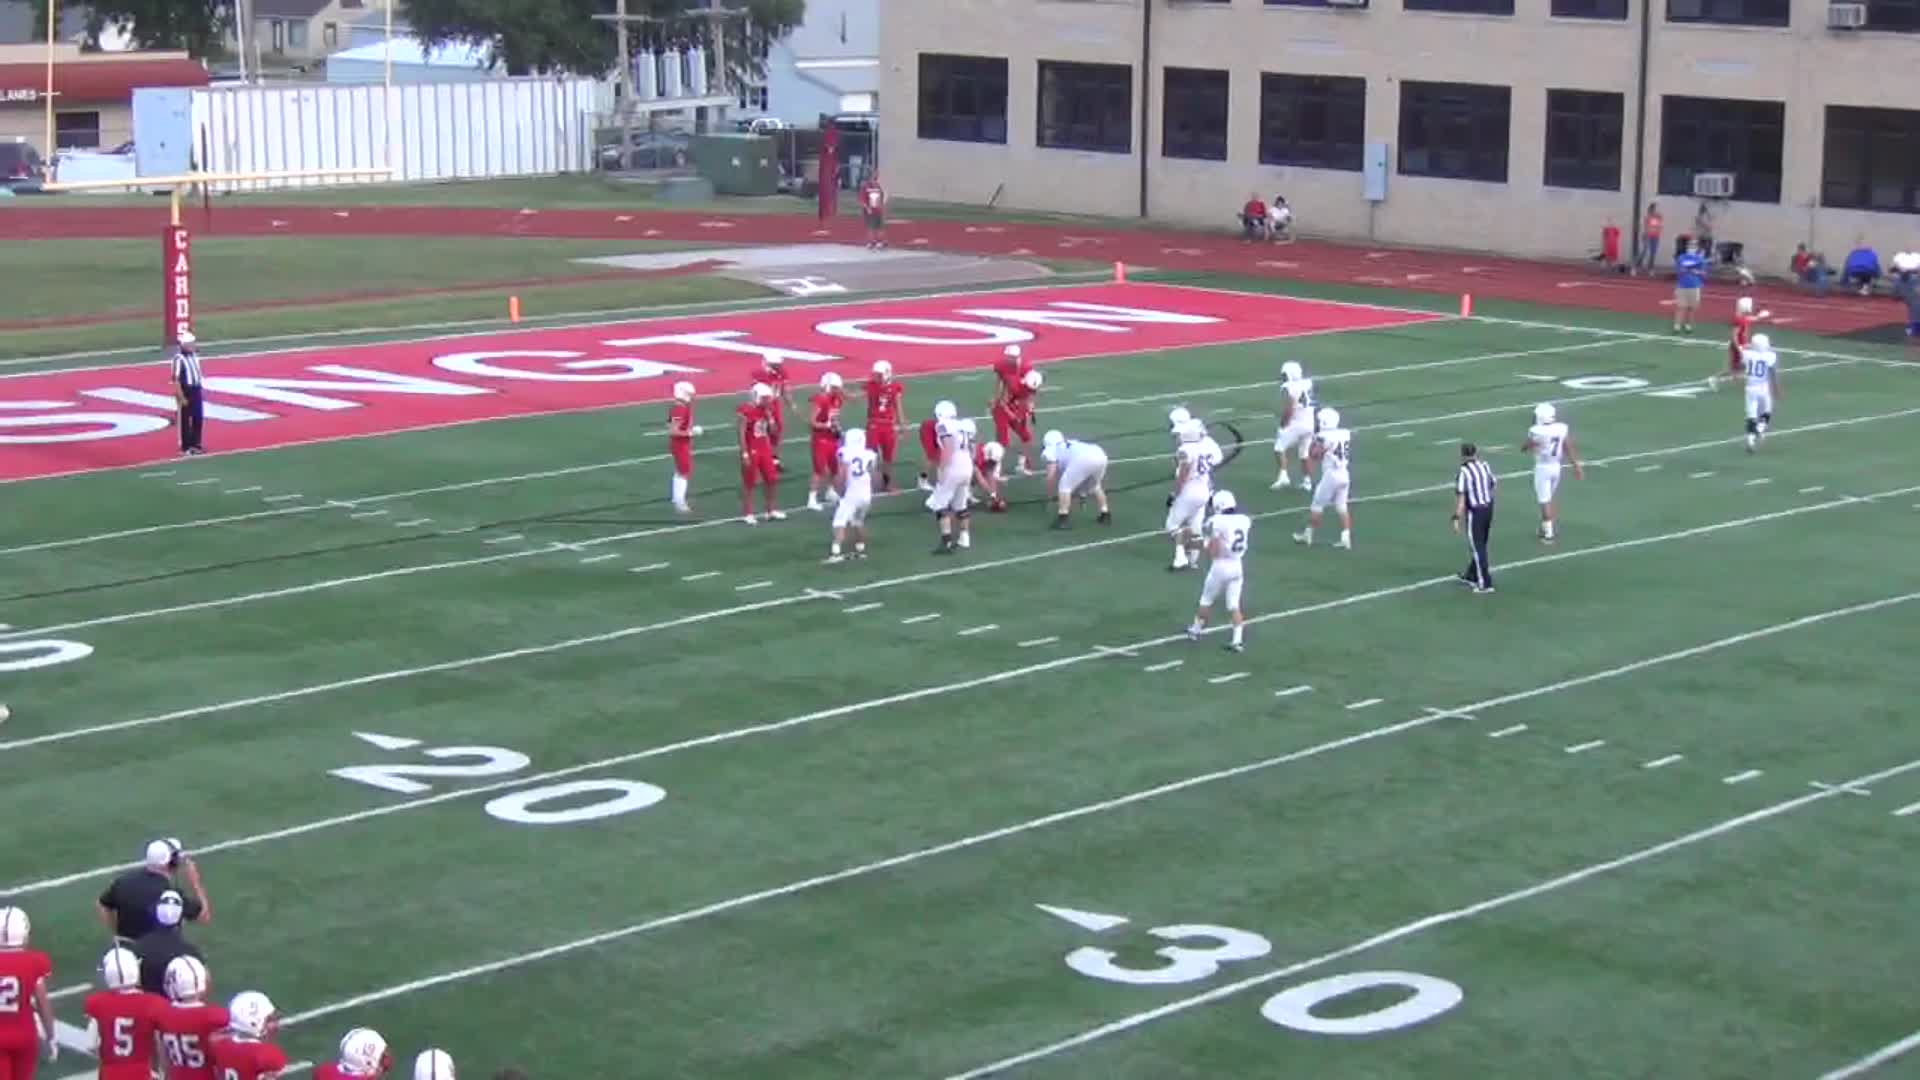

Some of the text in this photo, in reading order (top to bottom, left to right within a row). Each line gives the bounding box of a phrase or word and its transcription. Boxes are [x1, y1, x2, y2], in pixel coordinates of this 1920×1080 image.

[1745, 359, 1766, 378] 10
[1231, 529, 1245, 553] 2
[113, 1016, 135, 1057] 5
